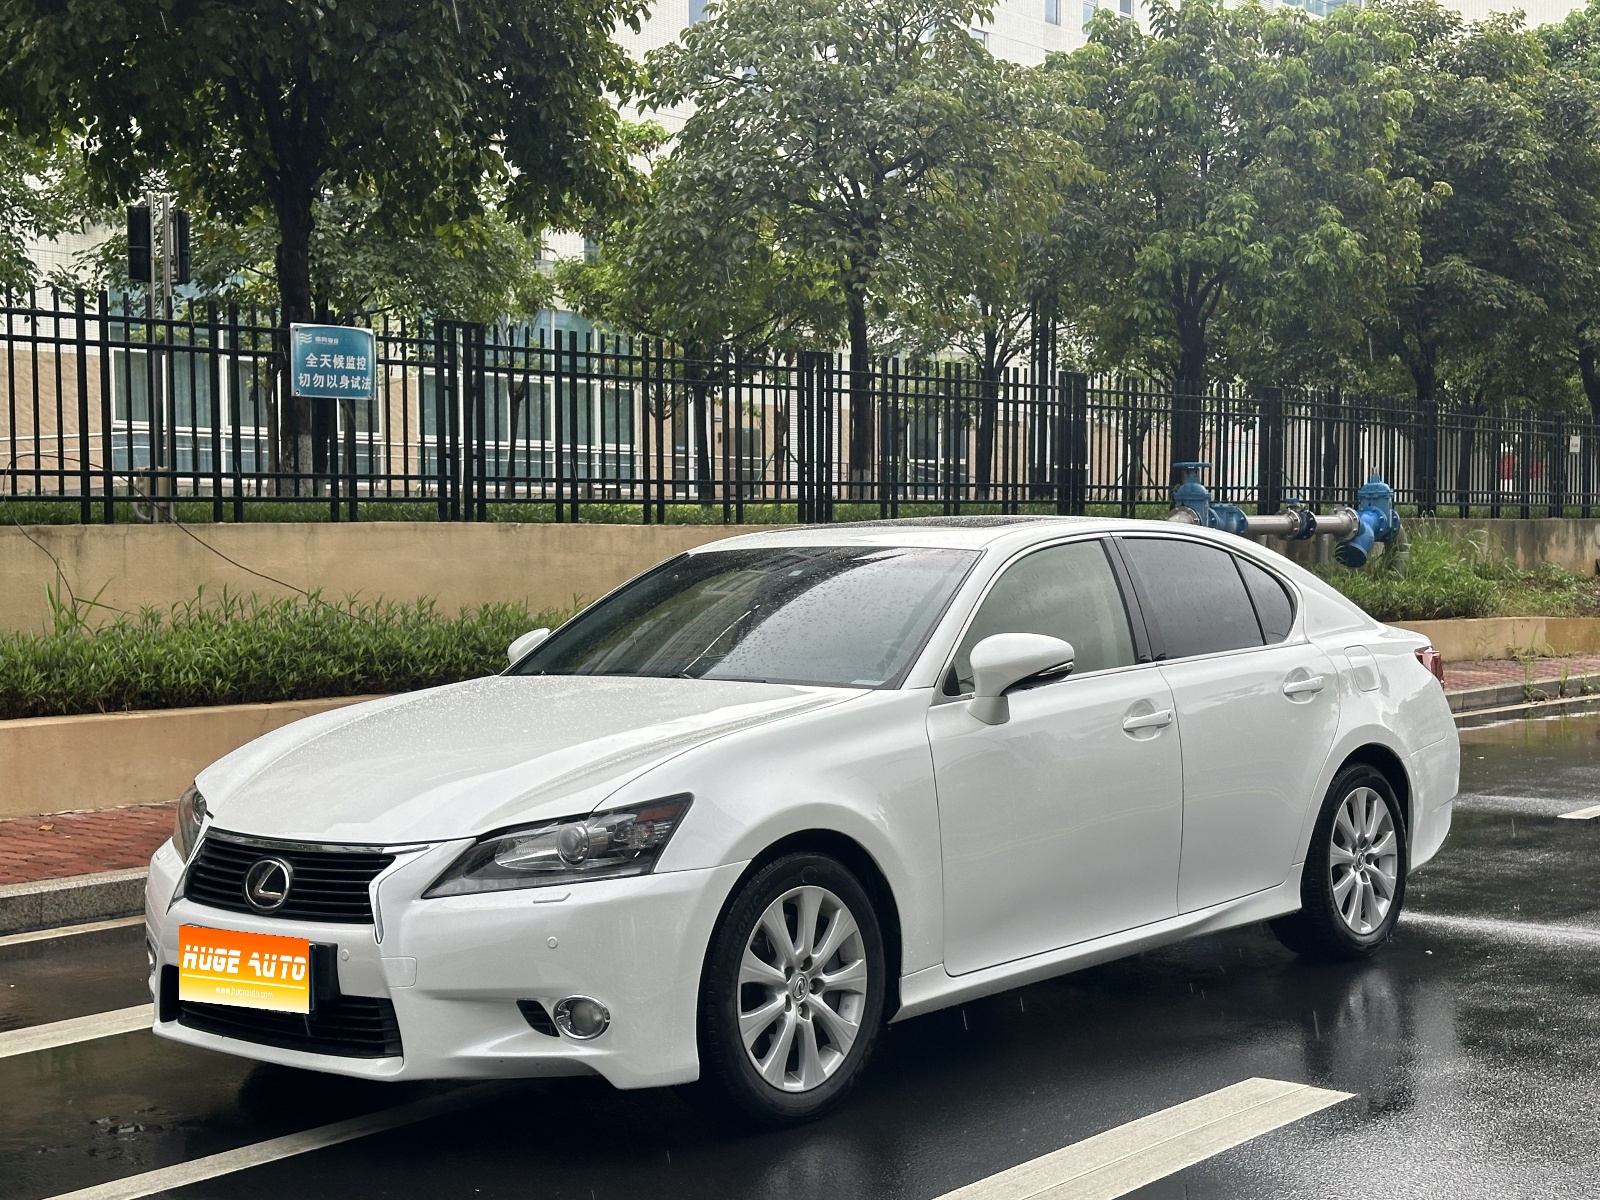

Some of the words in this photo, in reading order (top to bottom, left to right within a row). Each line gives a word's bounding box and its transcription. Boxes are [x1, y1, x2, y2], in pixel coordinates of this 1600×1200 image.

[305, 352, 366, 370] 全天候监控
[298, 372, 372, 390] 切勿以身试法
